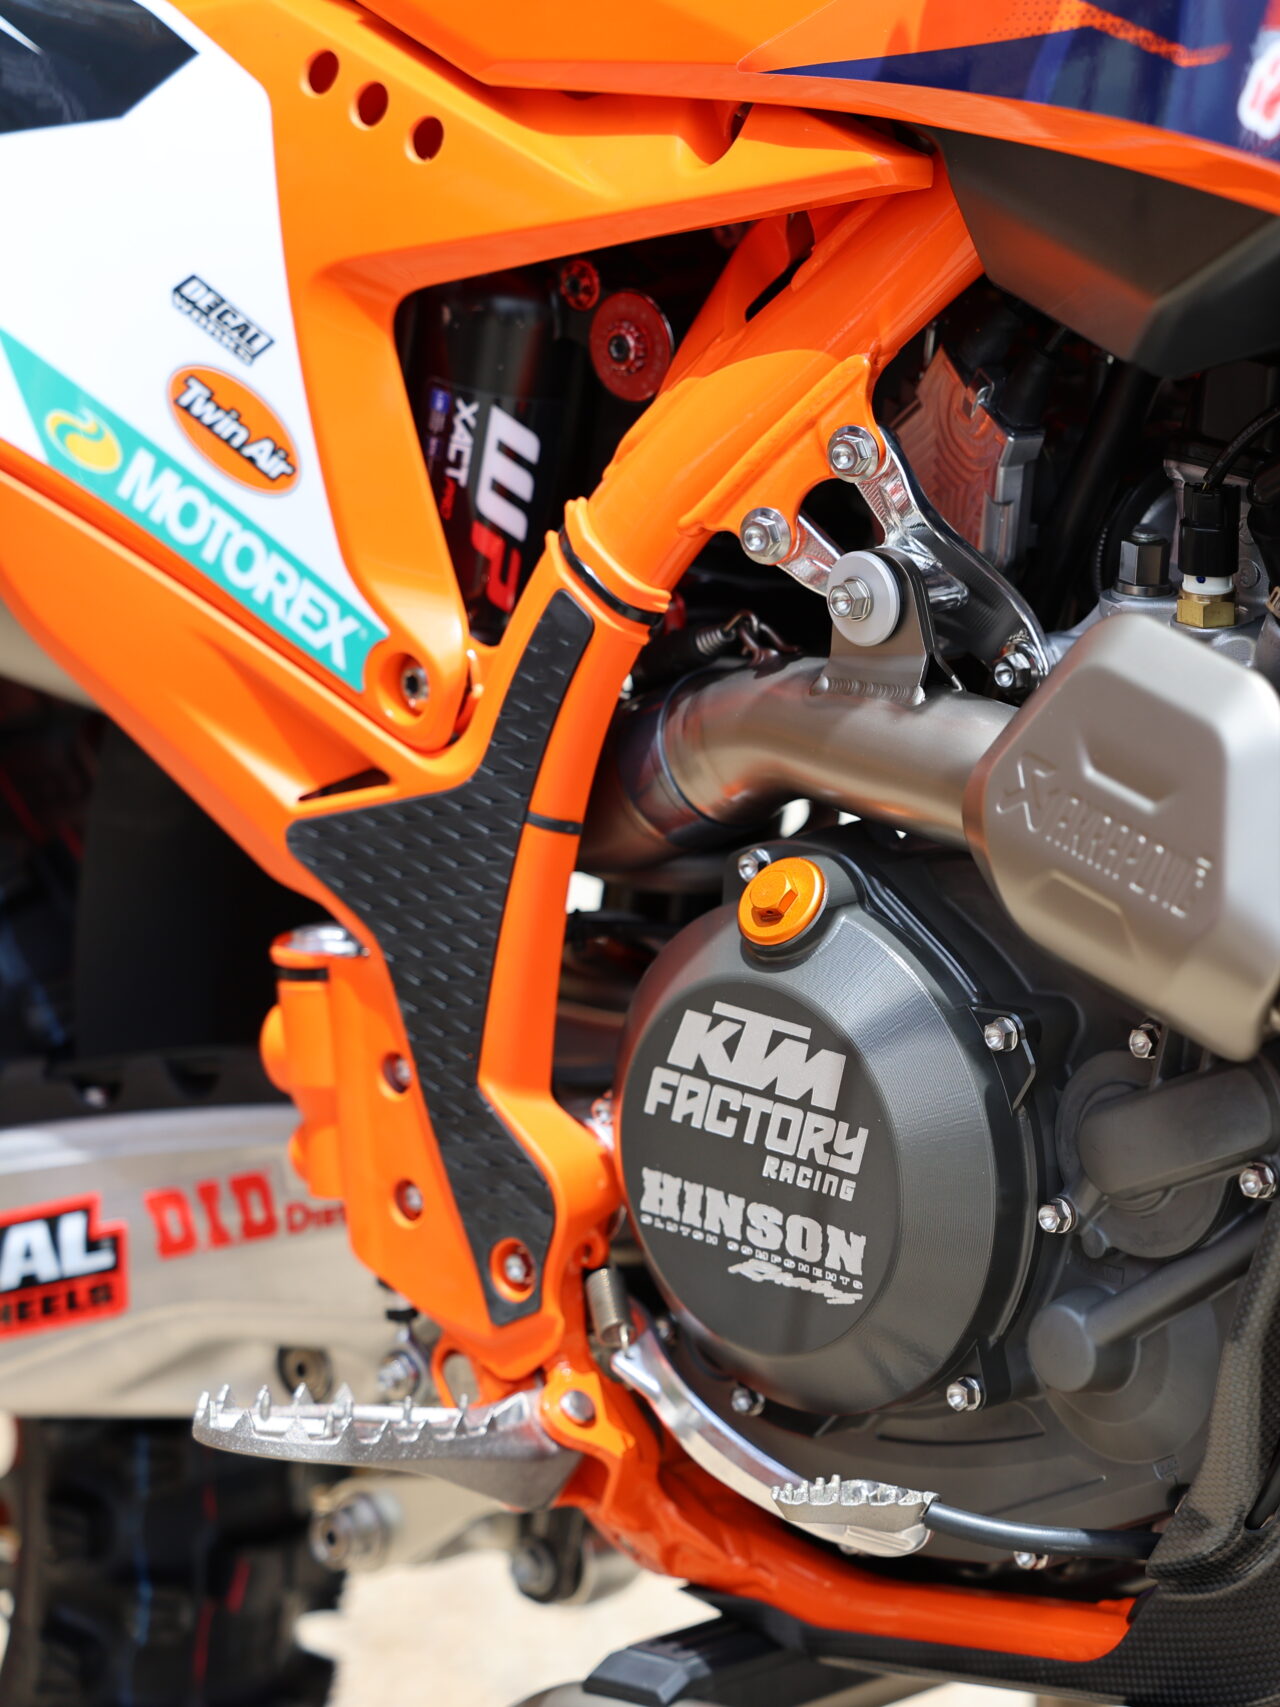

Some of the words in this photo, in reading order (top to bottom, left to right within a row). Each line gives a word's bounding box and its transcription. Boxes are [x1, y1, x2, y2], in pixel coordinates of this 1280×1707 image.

[175, 375, 251, 450] Twin
[240, 436, 297, 482] Air
[445, 398, 479, 488] XACT
[116, 445, 361, 672] MOTOREX
[667, 1000, 847, 1112] KTM
[643, 1066, 869, 1175] FACTORY
[640, 1166, 867, 1276] HINSON
[762, 1155, 857, 1202] RACING
